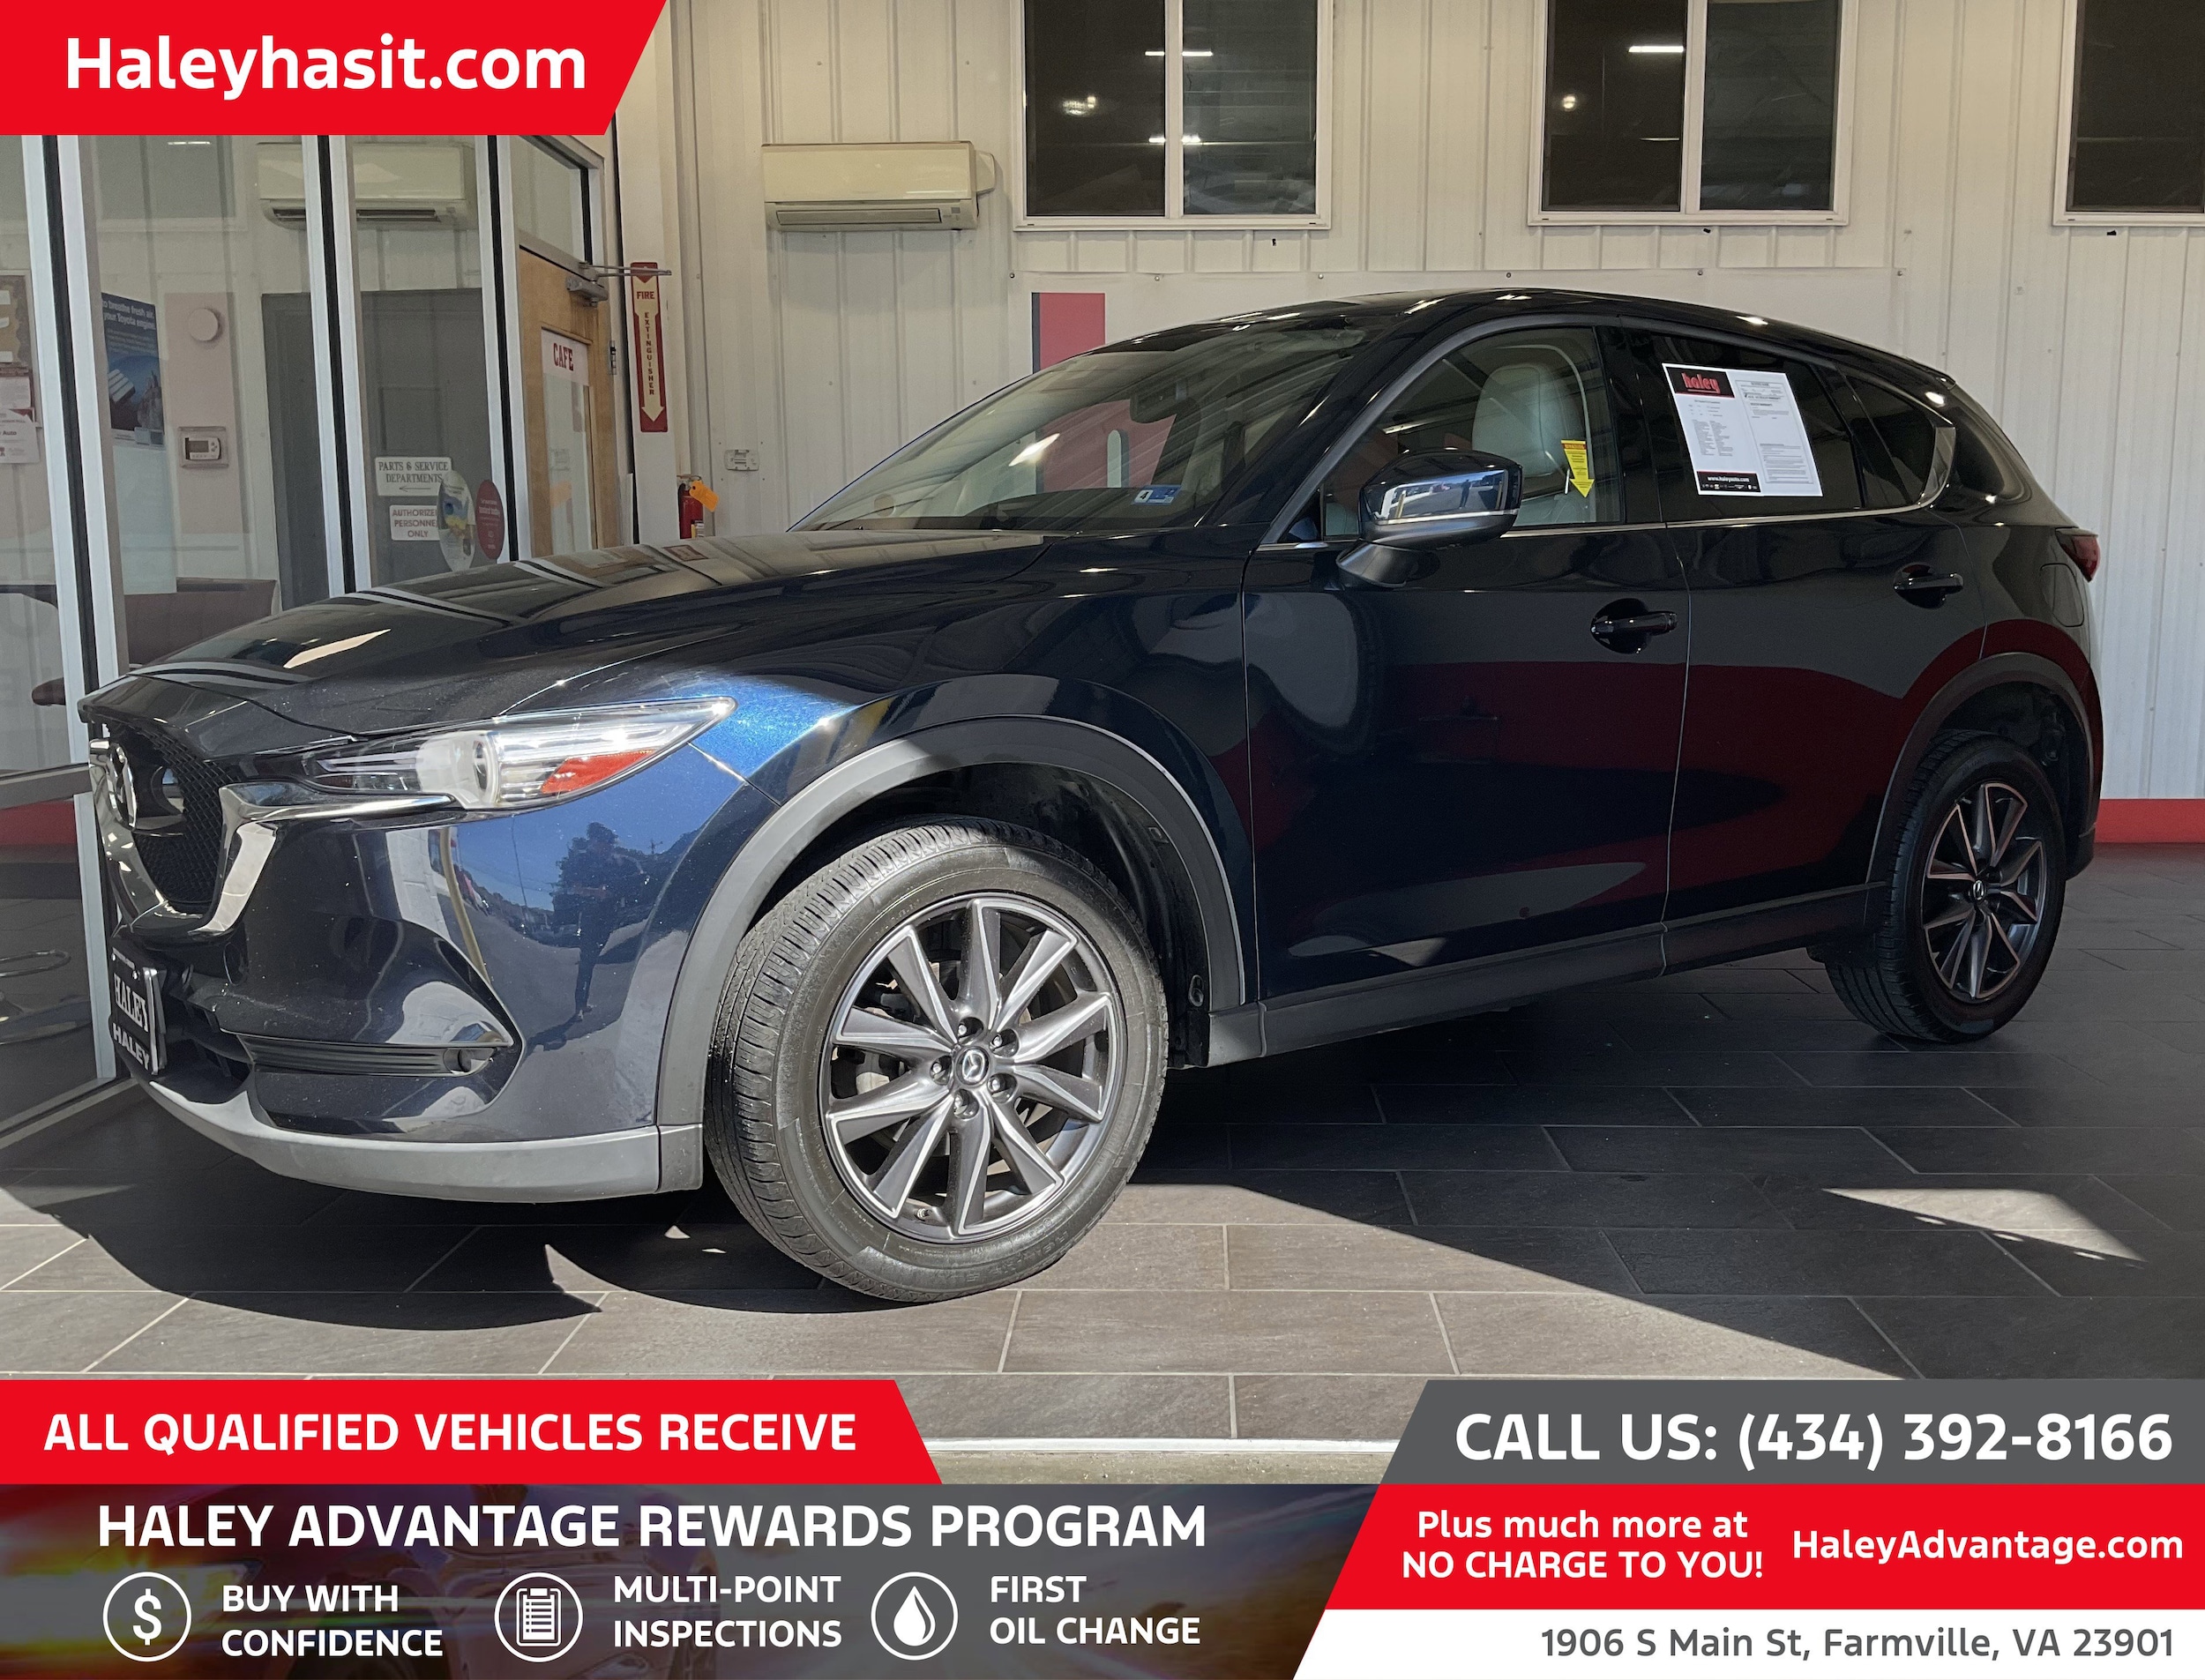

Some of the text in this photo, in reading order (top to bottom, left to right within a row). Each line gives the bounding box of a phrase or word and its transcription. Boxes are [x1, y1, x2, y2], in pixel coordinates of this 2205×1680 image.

[636, 291, 655, 300] FIRE
[131, 305, 146, 317] fresh
[117, 312, 137, 325] Toyota
[552, 342, 574, 371] CAFE
[644, 311, 655, 396] EXTINGUISHER
[1681, 372, 1721, 394] haley
[378, 461, 449, 472] PARTS & SERVICE
[385, 473, 444, 483] DEPARTMENTS
[392, 509, 437, 518] AUTHORIZE
[394, 519, 438, 527] PERSONNE
[113, 972, 149, 1033] HALEY
[112, 1022, 150, 1071] HALEY
